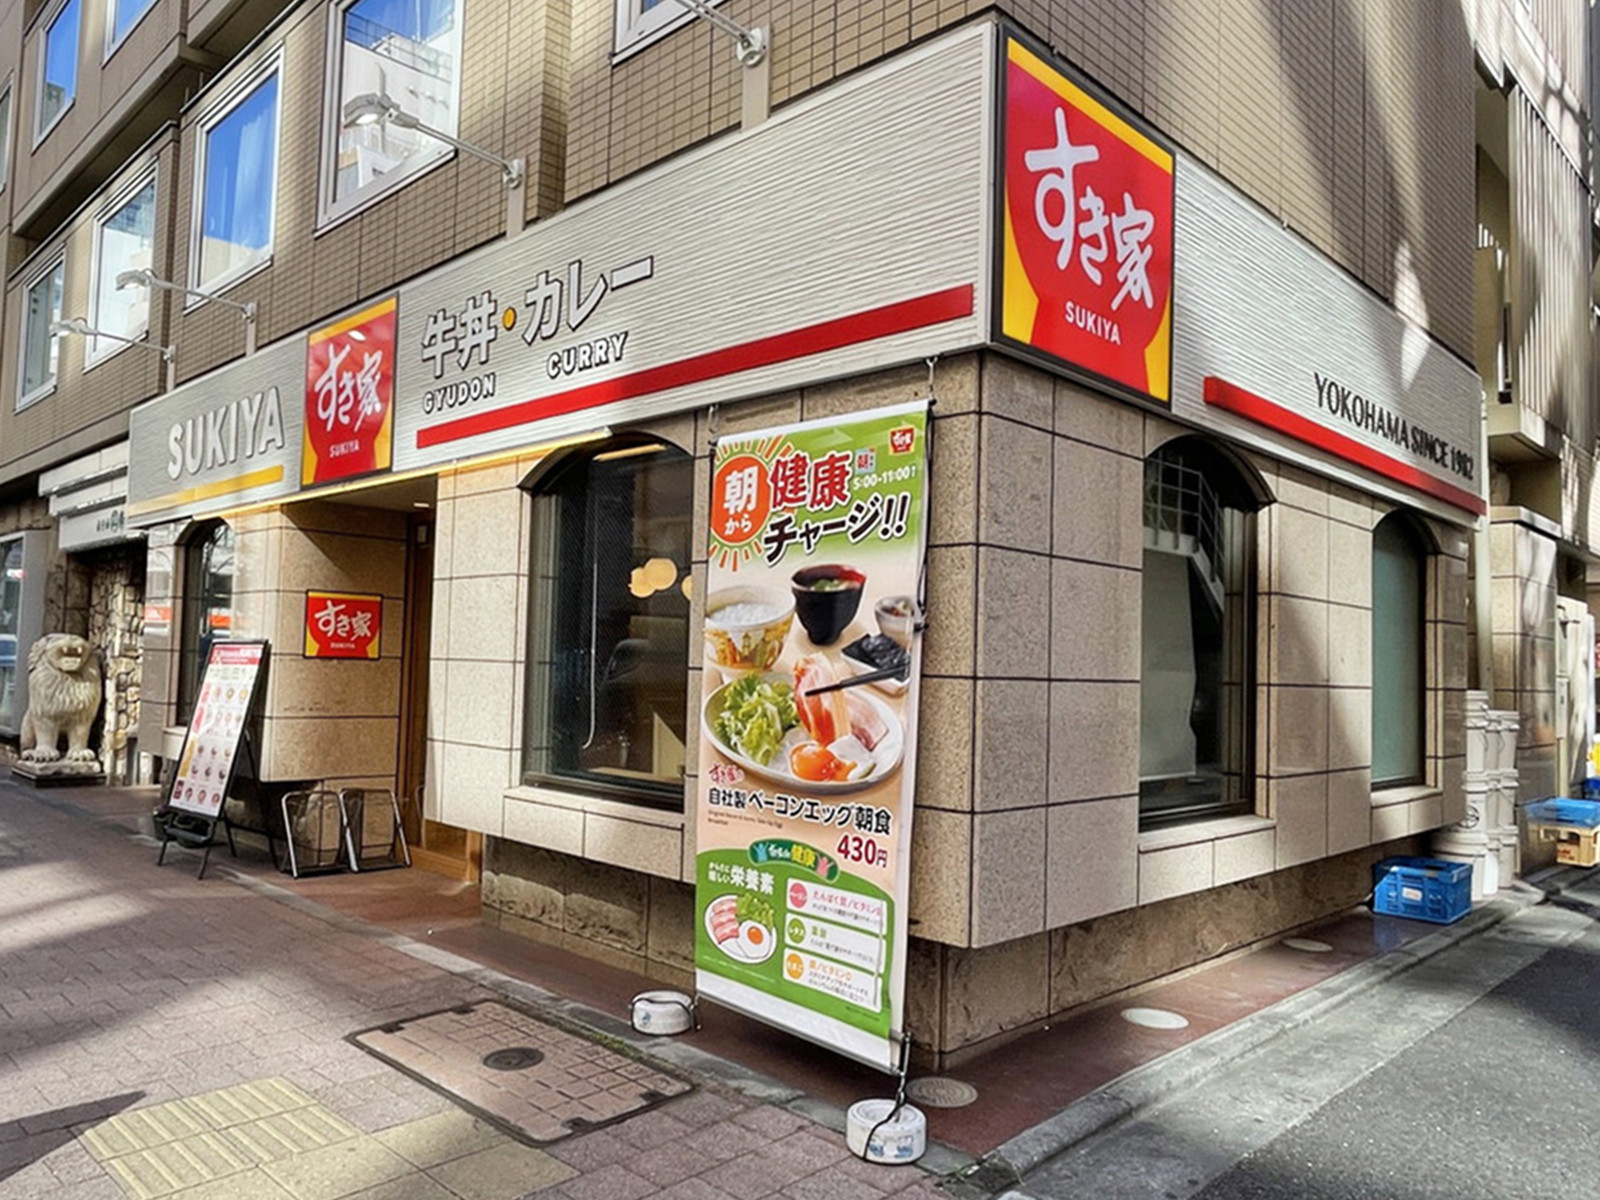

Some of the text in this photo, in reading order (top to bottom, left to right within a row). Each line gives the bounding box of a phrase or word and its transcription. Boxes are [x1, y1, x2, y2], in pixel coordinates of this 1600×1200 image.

[1024, 106, 1155, 311] すき家
[1065, 301, 1121, 345] SUKIYA
[314, 343, 383, 433] すき家
[423, 331, 628, 414] GYUDON CURRY
[167, 386, 285, 480] SUKIYA
[329, 439, 360, 458] SUKIYA
[1314, 371, 1409, 450] YOKOHAMA
[1411, 426, 1449, 469] SINCE
[724, 466, 758, 514] 朝
[769, 452, 851, 510] 健康
[725, 514, 752, 535] から
[314, 600, 372, 641] すき家
